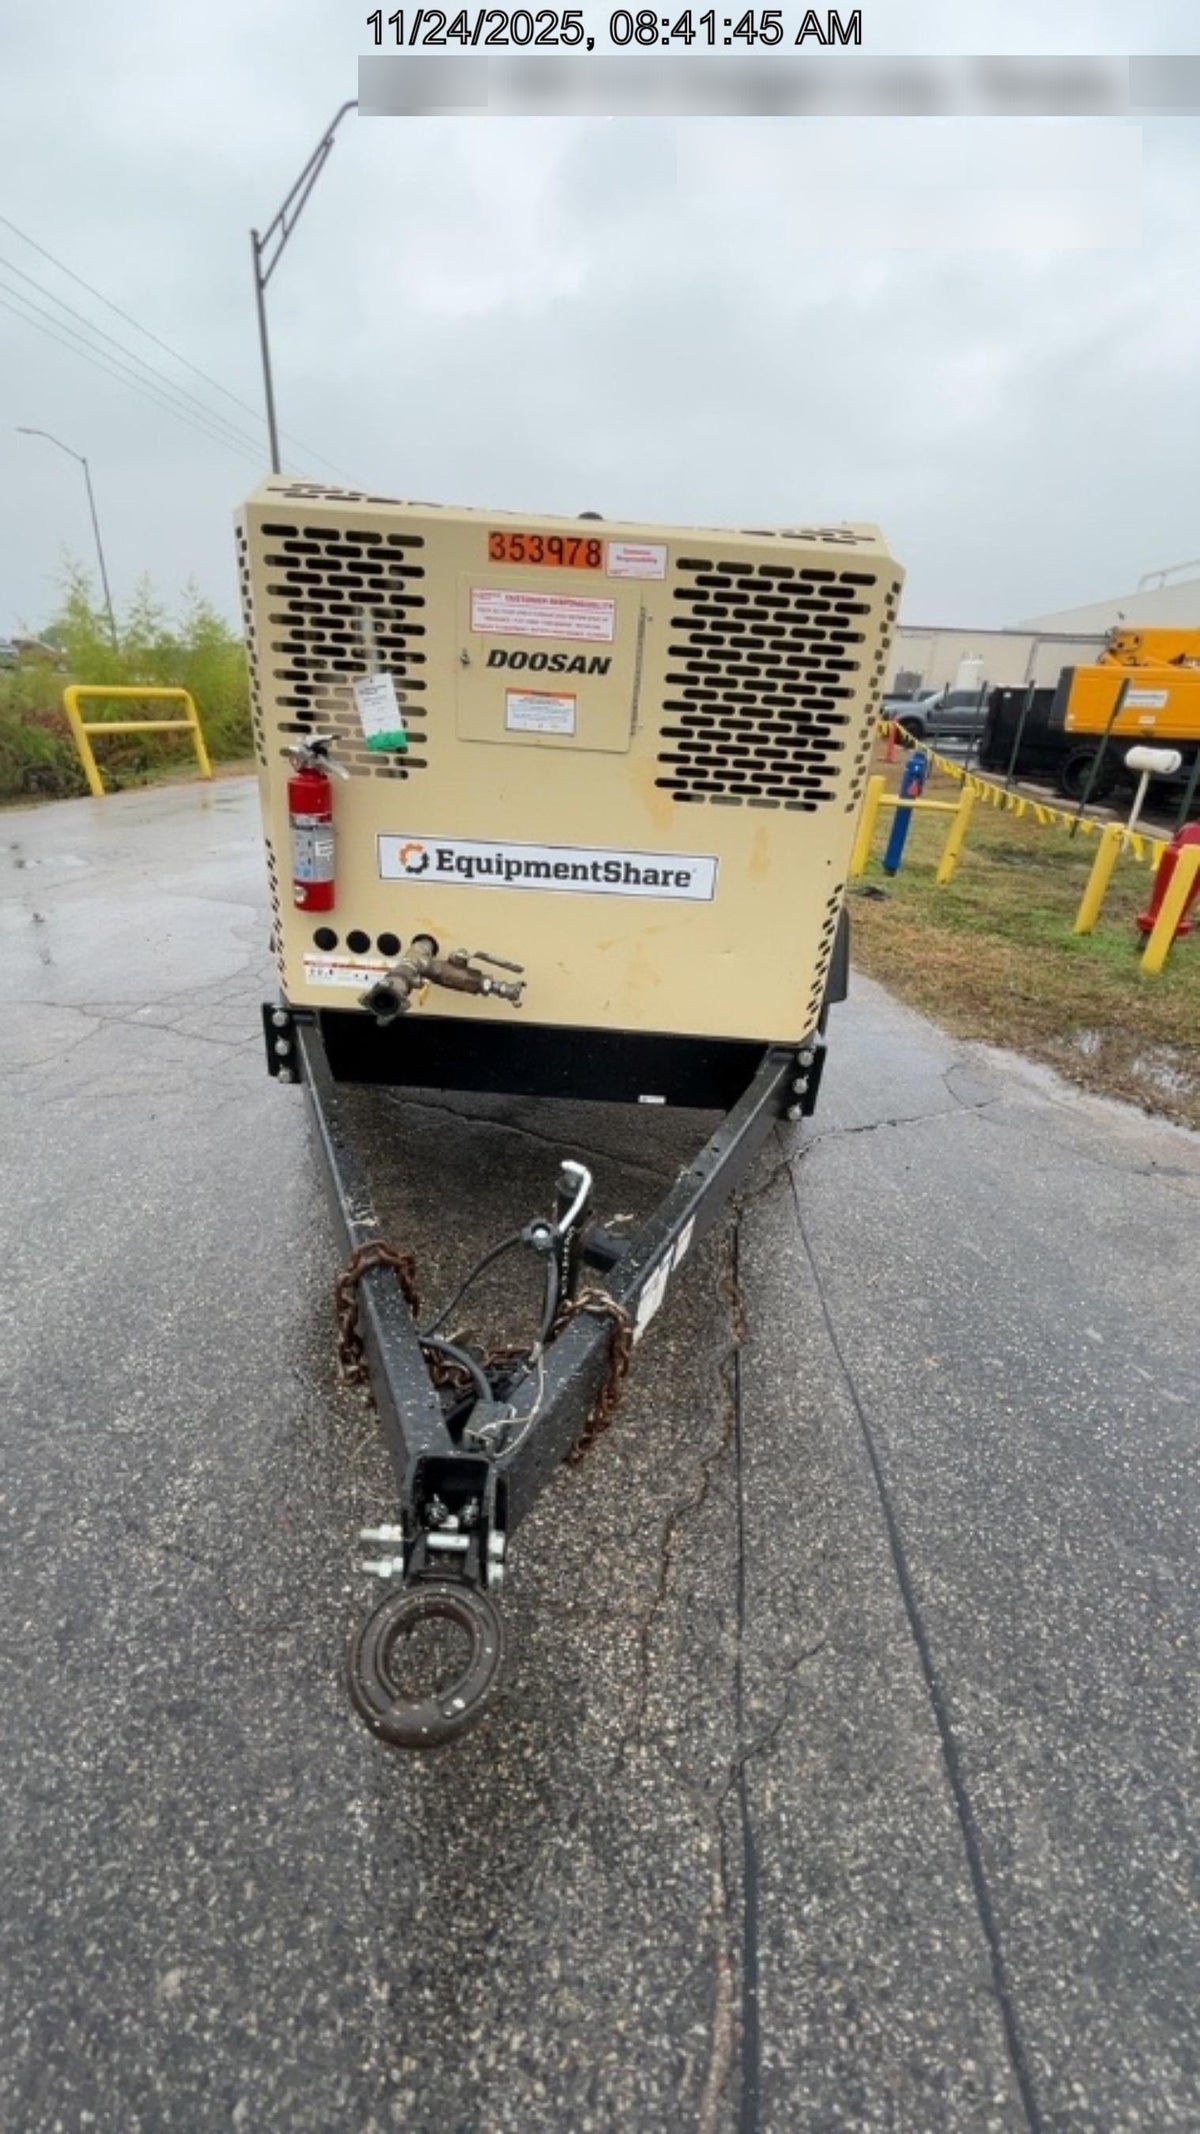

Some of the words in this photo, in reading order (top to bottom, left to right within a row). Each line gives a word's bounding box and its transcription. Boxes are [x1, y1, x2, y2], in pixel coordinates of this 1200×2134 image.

[489, 532, 602, 568] 353978
[486, 649, 613, 676] DOOSAN
[435, 848, 692, 888] EquipmentShare
